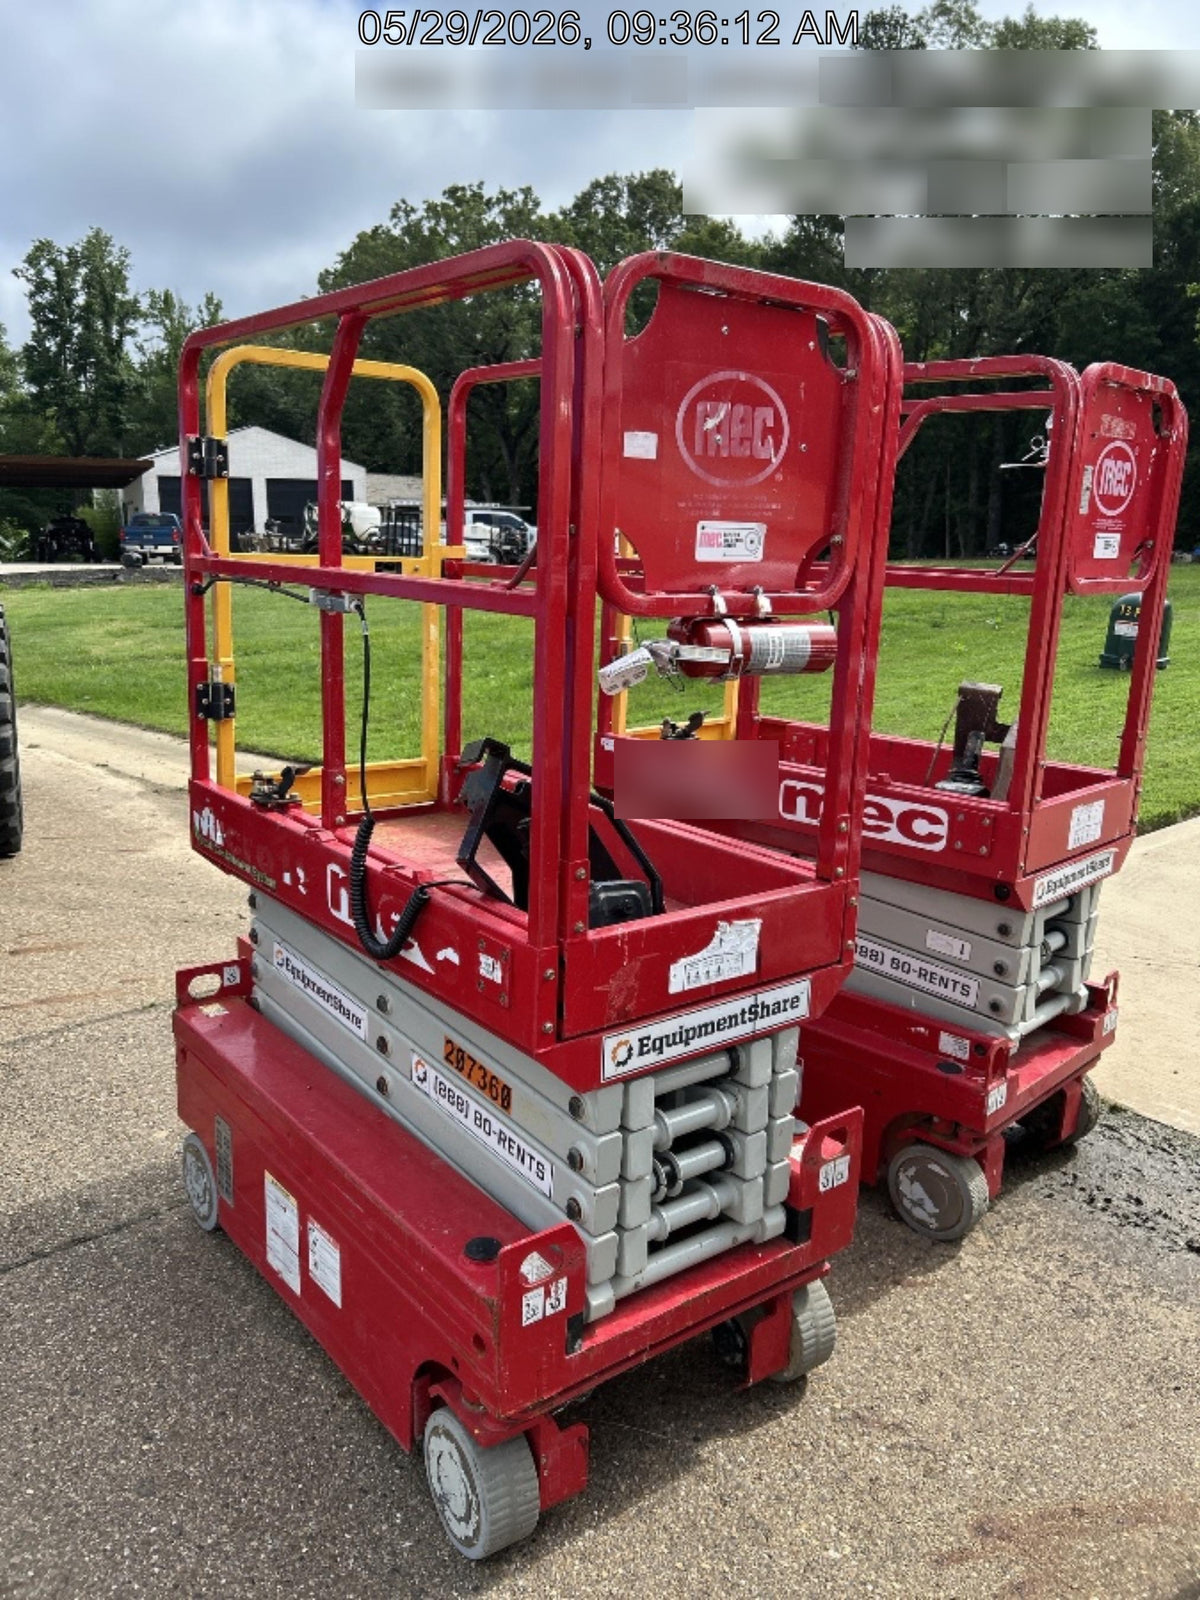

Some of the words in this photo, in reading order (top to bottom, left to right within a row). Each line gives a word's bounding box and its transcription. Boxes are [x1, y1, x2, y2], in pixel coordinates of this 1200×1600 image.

[285, 955, 363, 1030] EquipmentShare
[854, 943, 885, 966] 88)
[890, 957, 971, 998] 80-RENTS
[636, 993, 800, 1057] EquipmentShare
[444, 1038, 512, 1112] 207360
[434, 1074, 468, 1120] (888)
[473, 1111, 546, 1182] 80-RENTS
